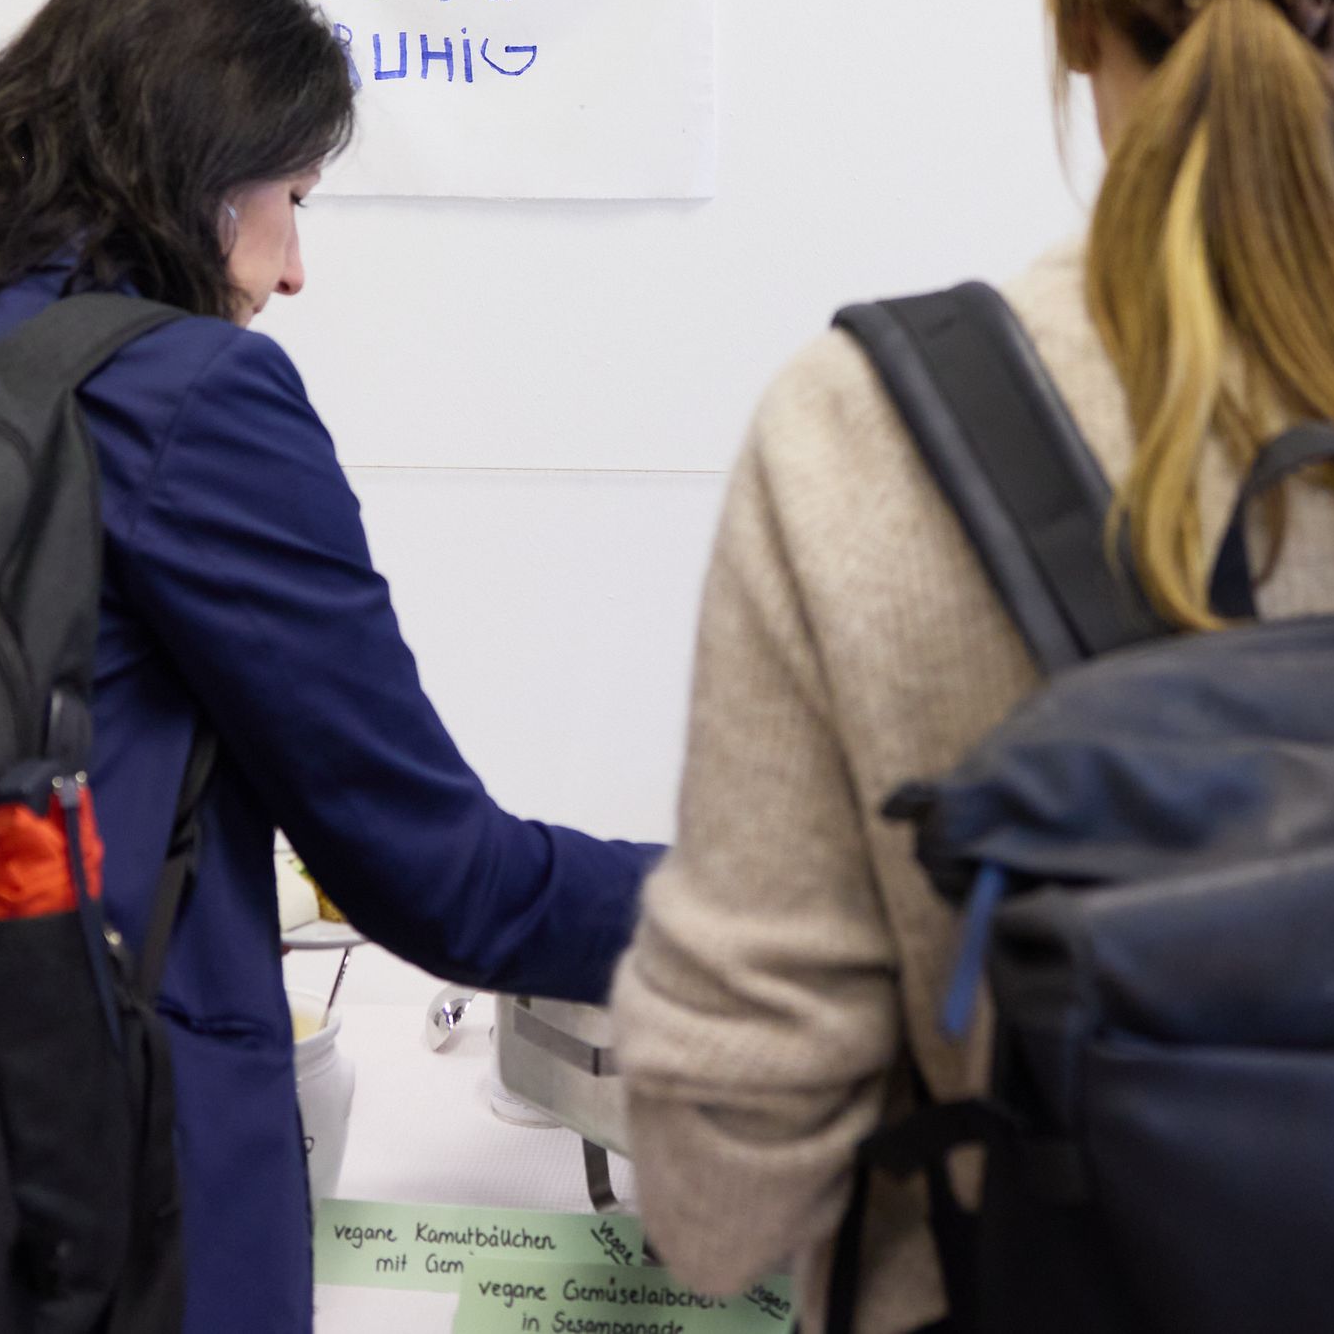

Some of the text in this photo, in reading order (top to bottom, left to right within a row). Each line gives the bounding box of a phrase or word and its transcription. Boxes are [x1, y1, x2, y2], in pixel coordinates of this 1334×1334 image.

[376, 1253, 464, 1274] mit Gem
[522, 1312, 540, 1332] in
